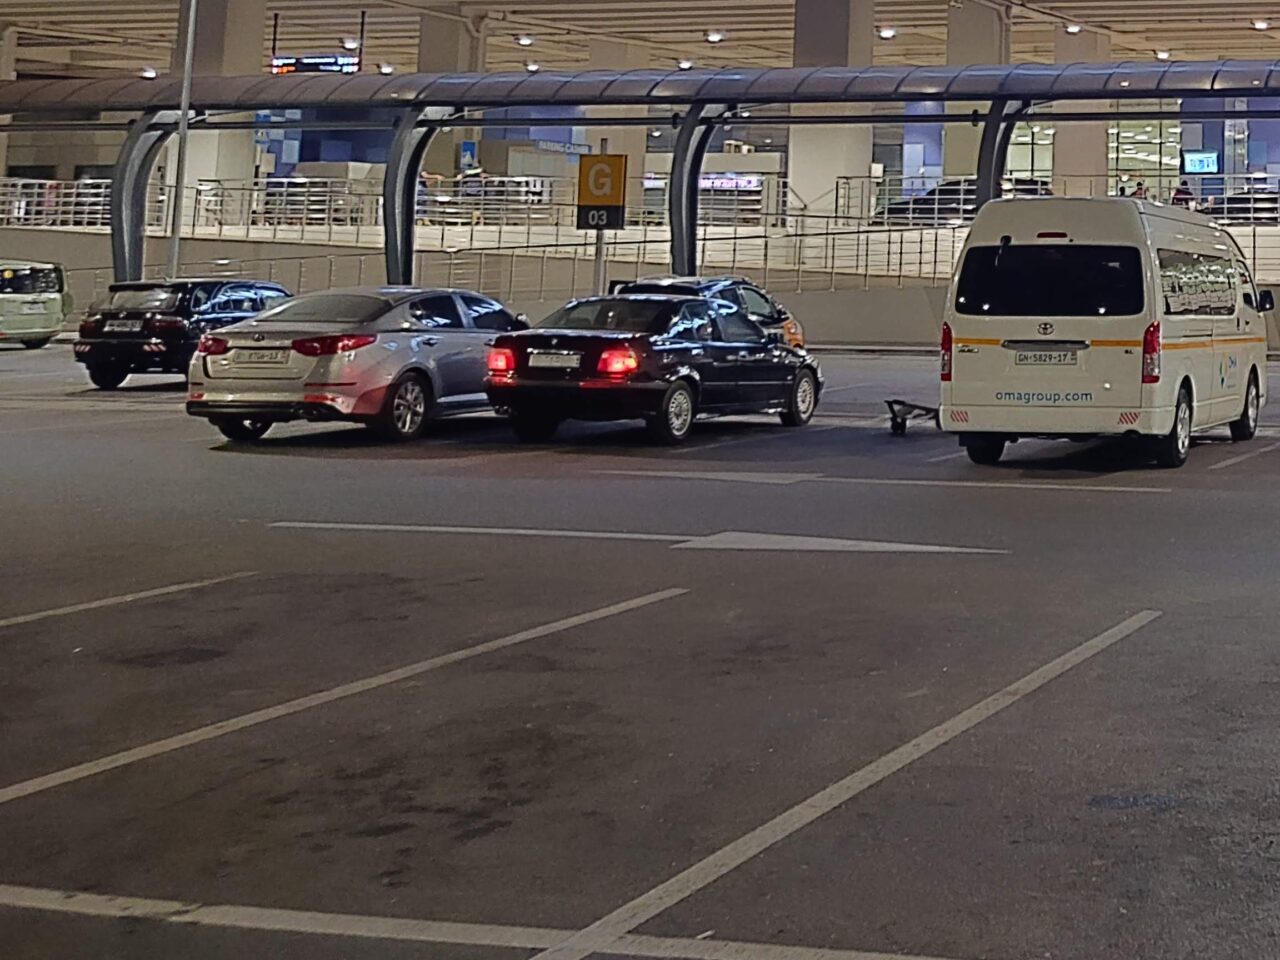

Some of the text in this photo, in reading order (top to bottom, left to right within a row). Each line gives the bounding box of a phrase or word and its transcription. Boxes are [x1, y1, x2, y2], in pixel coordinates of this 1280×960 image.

[588, 163, 612, 196] G
[588, 210, 607, 225] 03
[995, 391, 1093, 403] omagroup.com
